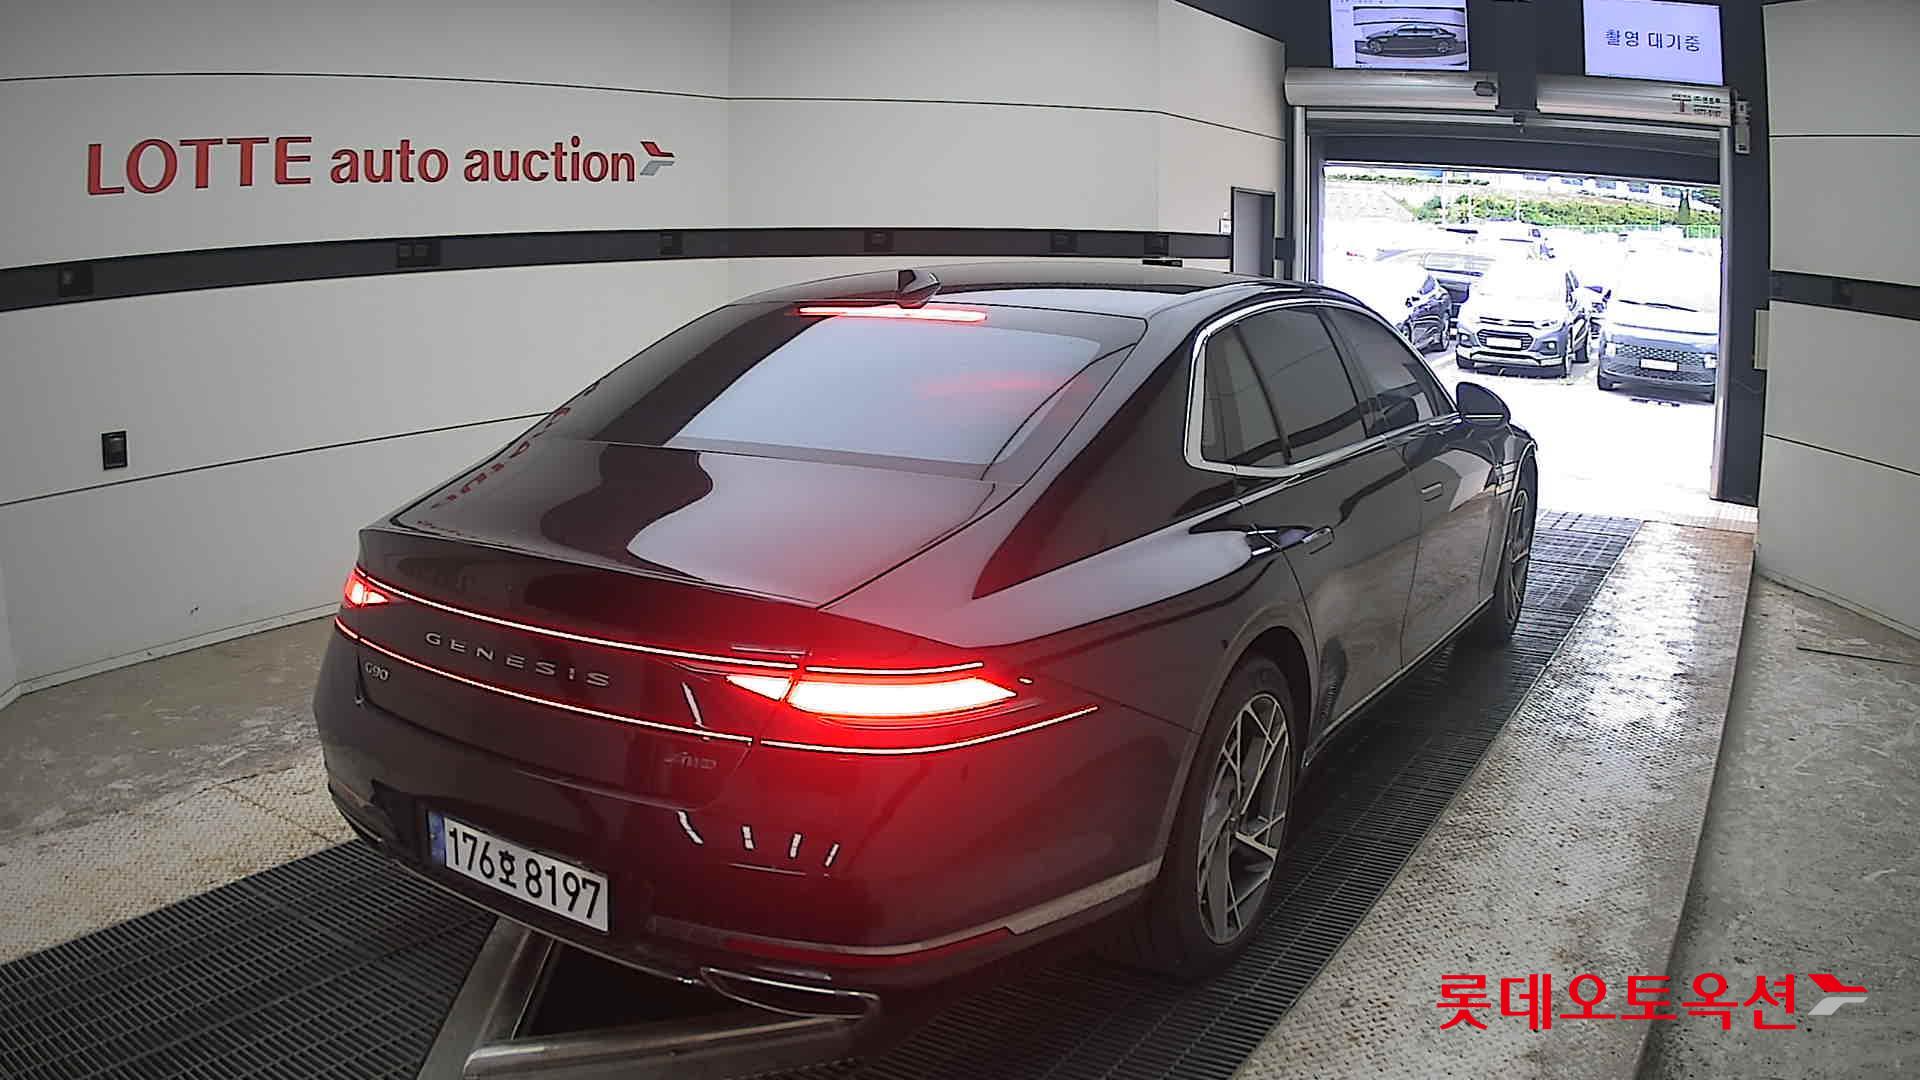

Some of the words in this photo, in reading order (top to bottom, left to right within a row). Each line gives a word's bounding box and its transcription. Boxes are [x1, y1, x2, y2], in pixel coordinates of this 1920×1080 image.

[1648, 32, 1701, 52] 대기중
[87, 136, 312, 196] LOTTE
[330, 138, 449, 184] auto
[463, 135, 636, 182] auction
[364, 661, 390, 681] G90
[425, 632, 610, 687] GENESIS
